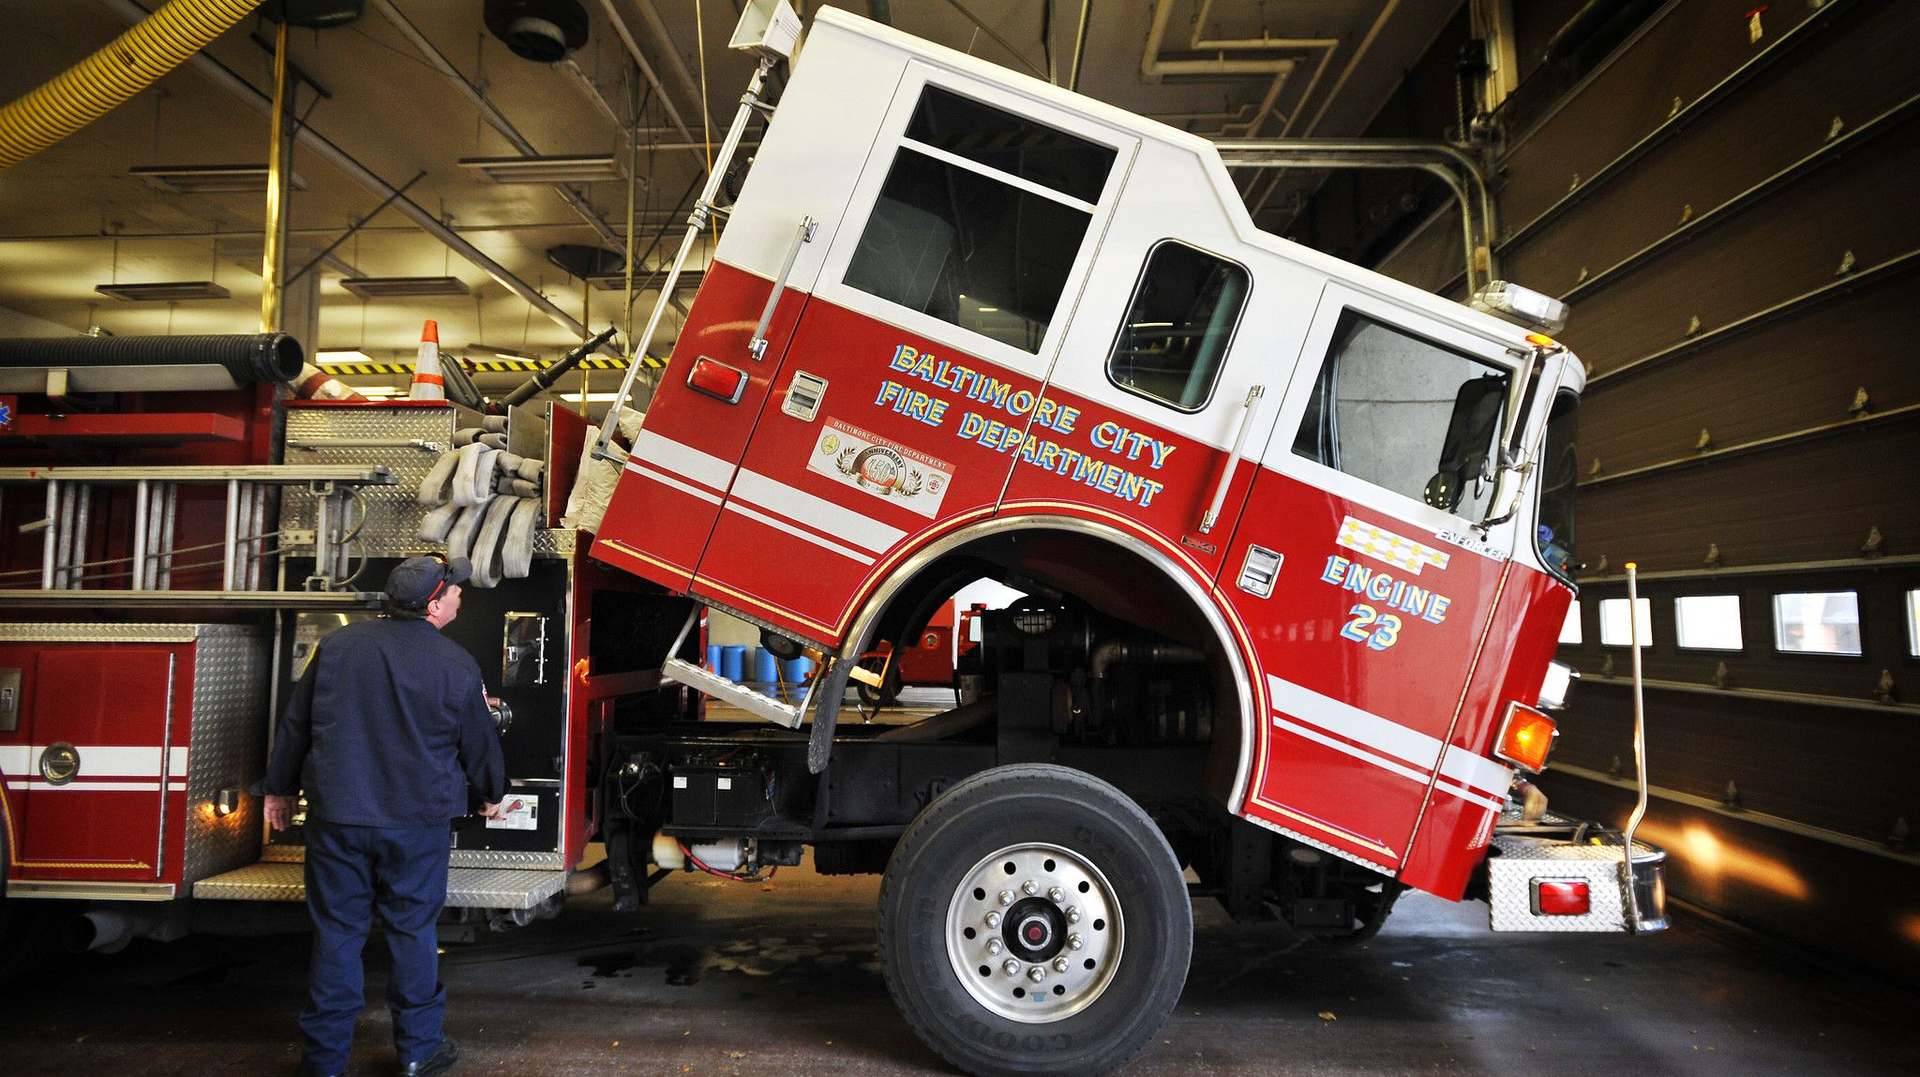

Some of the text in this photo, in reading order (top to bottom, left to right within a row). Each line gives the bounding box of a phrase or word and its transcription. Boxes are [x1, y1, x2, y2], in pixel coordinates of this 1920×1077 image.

[889, 343, 1178, 469] BALTIMORE CITY
[833, 420, 947, 470] BALTIMORE CITY FIRE DEPARTMENT
[865, 447, 905, 470] ANNIVERSARY
[875, 380, 1164, 507] FIRE DEPARTMENT
[1439, 530, 1508, 561] ENFORCER
[1320, 555, 1452, 625] ENGINE
[1339, 603, 1403, 651] 23
